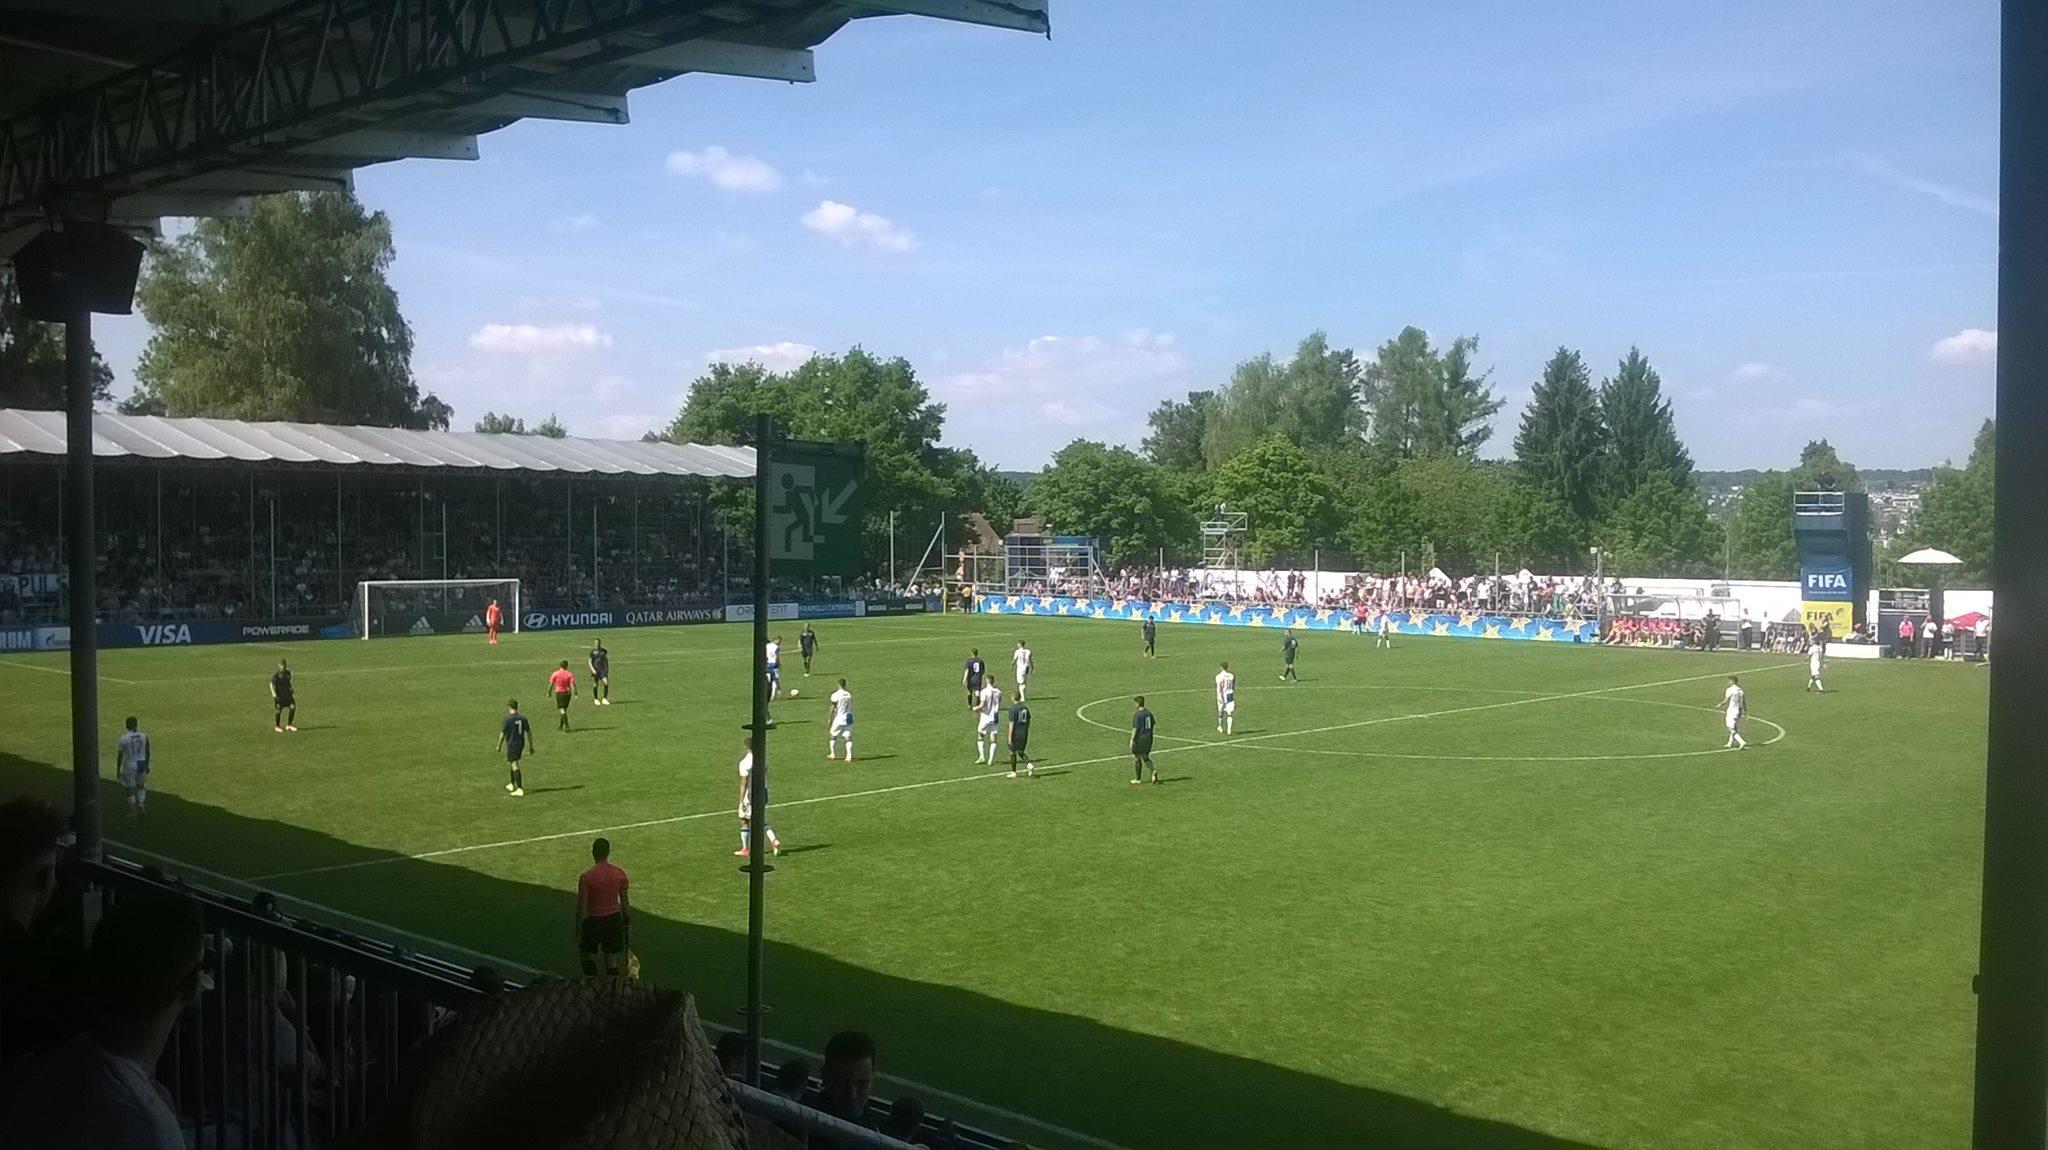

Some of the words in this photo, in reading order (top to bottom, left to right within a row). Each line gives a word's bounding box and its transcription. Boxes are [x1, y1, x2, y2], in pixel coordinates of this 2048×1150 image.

[1808, 574, 1847, 588] FIFA
[552, 612, 613, 626] HYUNDAI
[626, 610, 664, 624] QATAR
[668, 608, 711, 621] AIRWAYS
[1806, 611, 1834, 621] FIFA
[135, 624, 192, 644] VISA
[242, 624, 310, 636] POWERADE
[973, 661, 980, 673] 9
